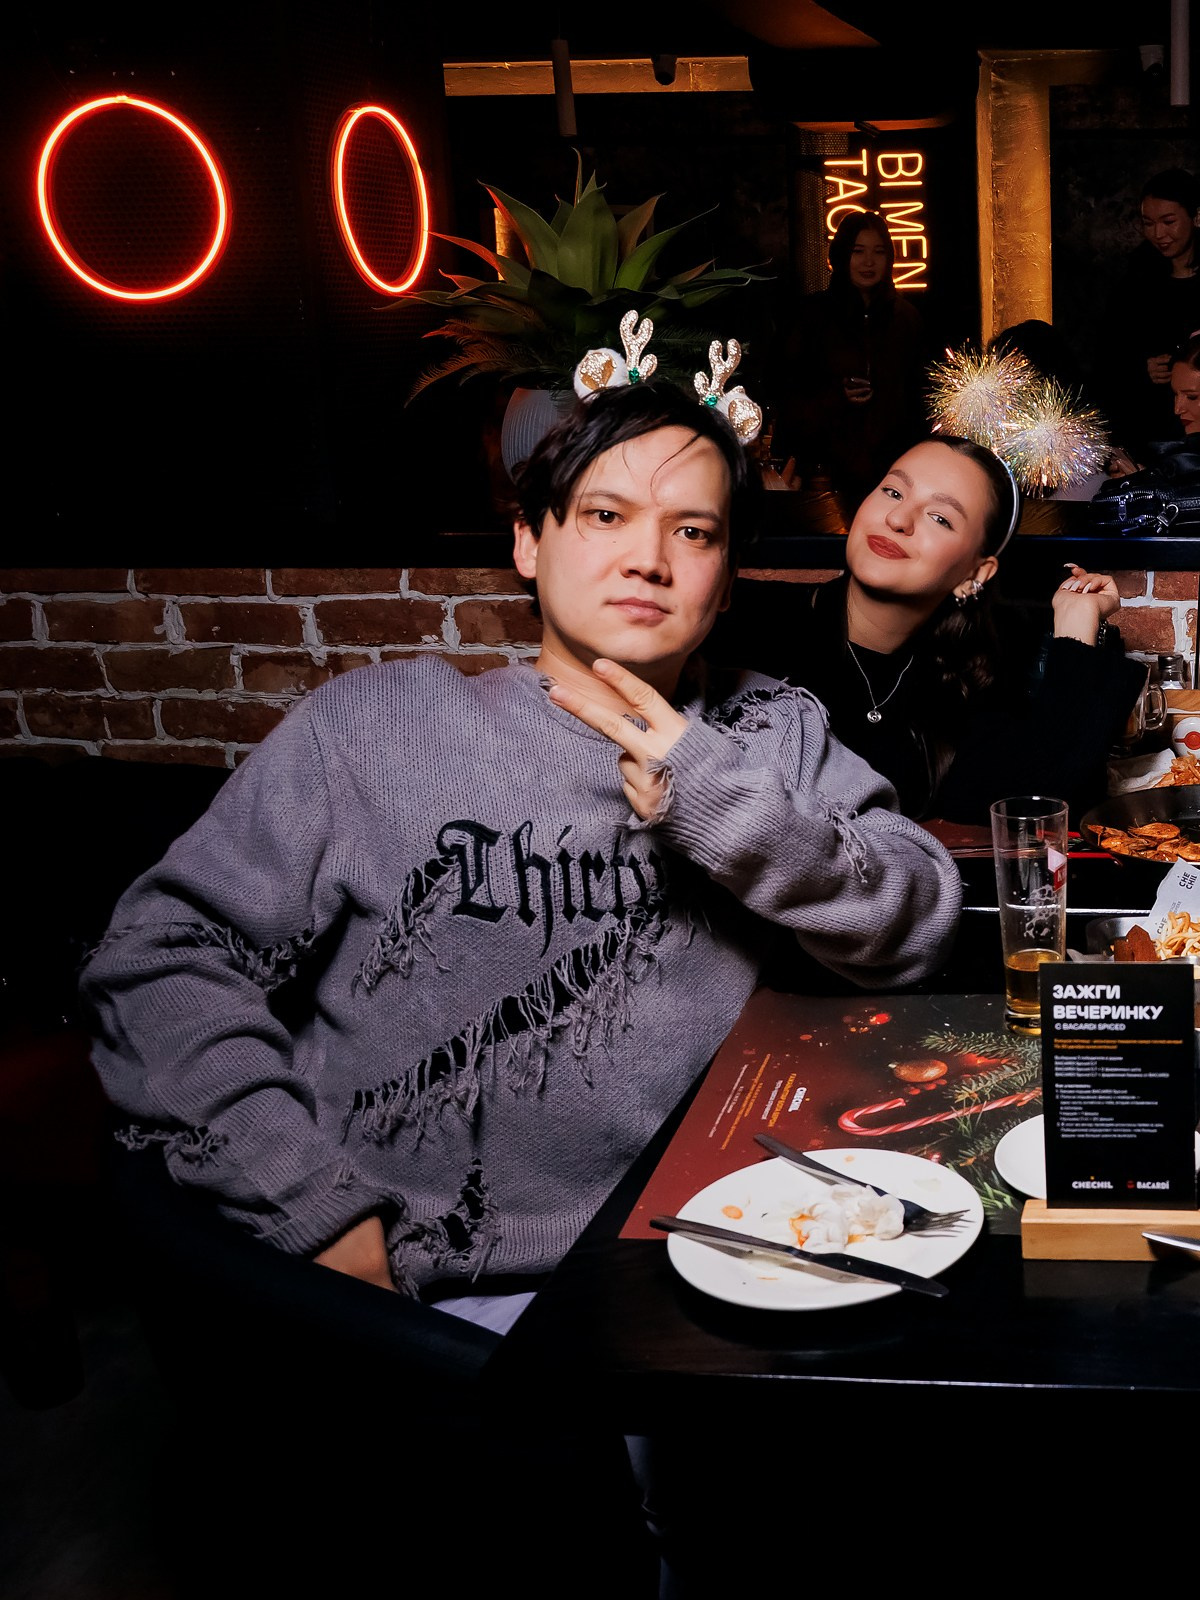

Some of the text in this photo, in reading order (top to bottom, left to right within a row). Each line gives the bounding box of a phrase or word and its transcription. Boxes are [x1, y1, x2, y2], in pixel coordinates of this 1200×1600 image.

[877, 152, 923, 187] BI
[1178, 871, 1191, 887] CHE
[1052, 984, 1121, 1000] ЗАЖГИ
[1053, 1004, 1164, 1020] ВЕЧЕРИНКУ
[1062, 1022, 1097, 1031] BACARDI
